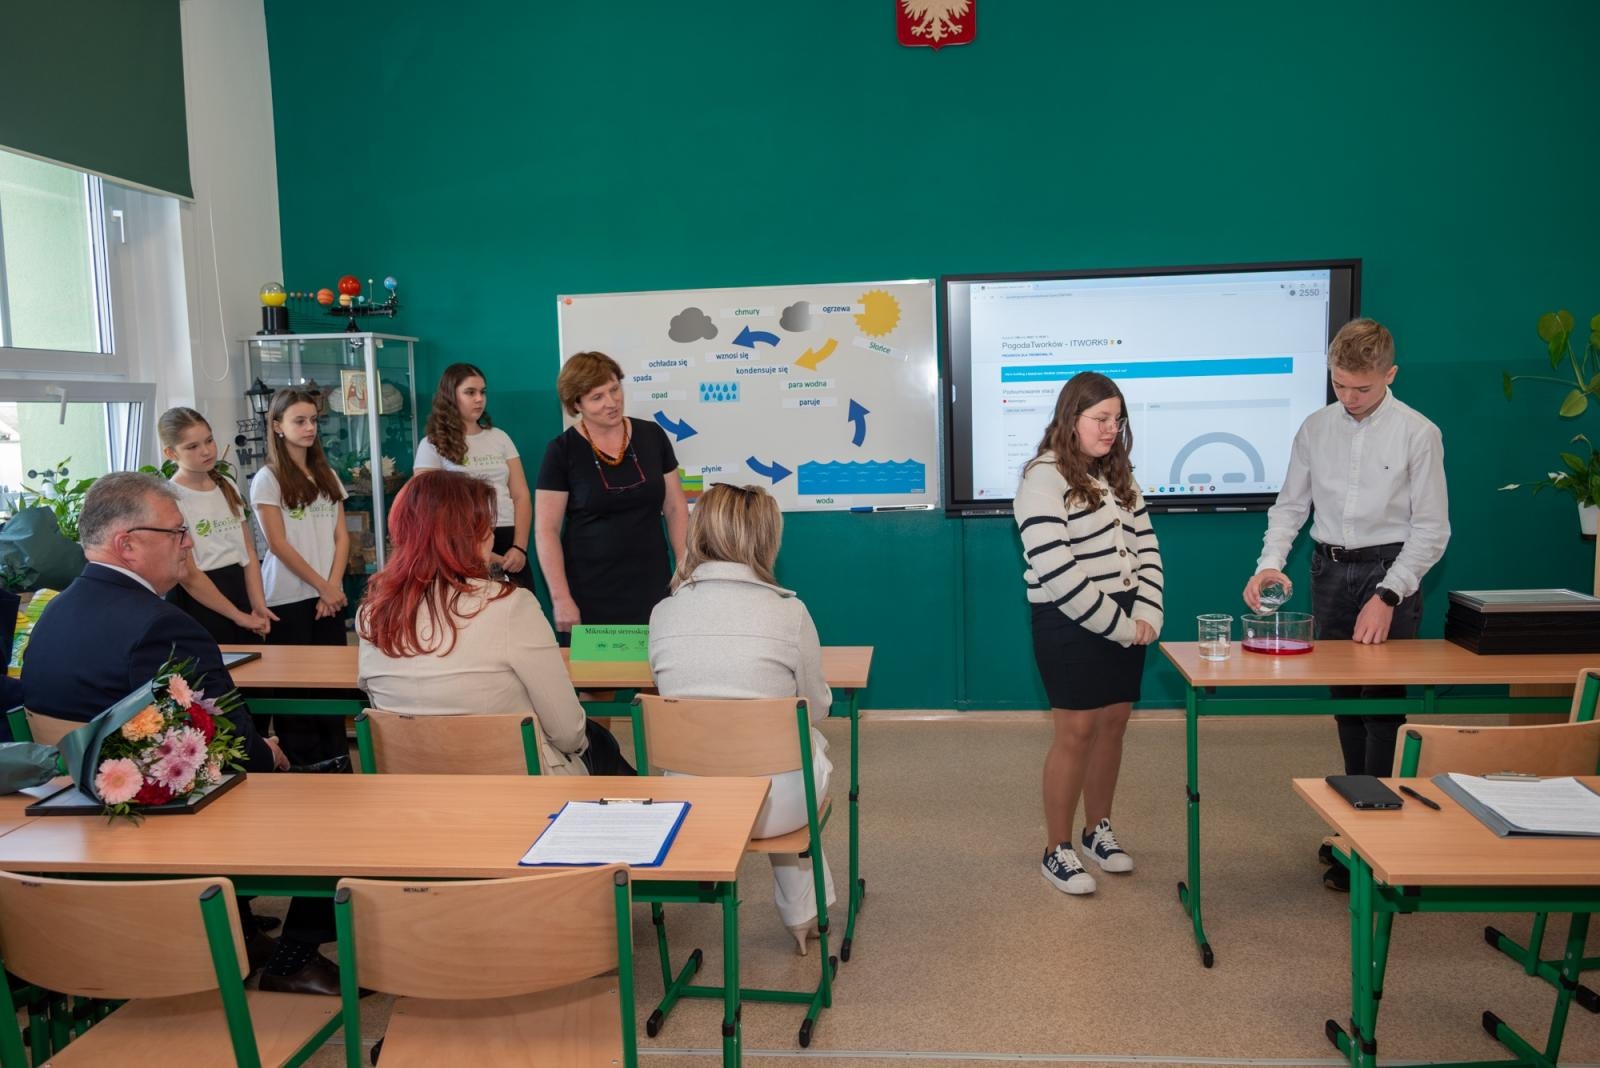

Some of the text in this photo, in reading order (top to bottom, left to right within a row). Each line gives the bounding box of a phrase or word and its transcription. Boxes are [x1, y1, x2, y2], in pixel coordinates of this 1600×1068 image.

[1299, 288, 1320, 296] 2550
[734, 308, 760, 316] chmury
[1002, 340, 1063, 350] PogodaTworków
[740, 352, 749, 360] się
[678, 359, 688, 367] się
[736, 366, 788, 376] kondensuje się
[701, 465, 722, 474] płynie
